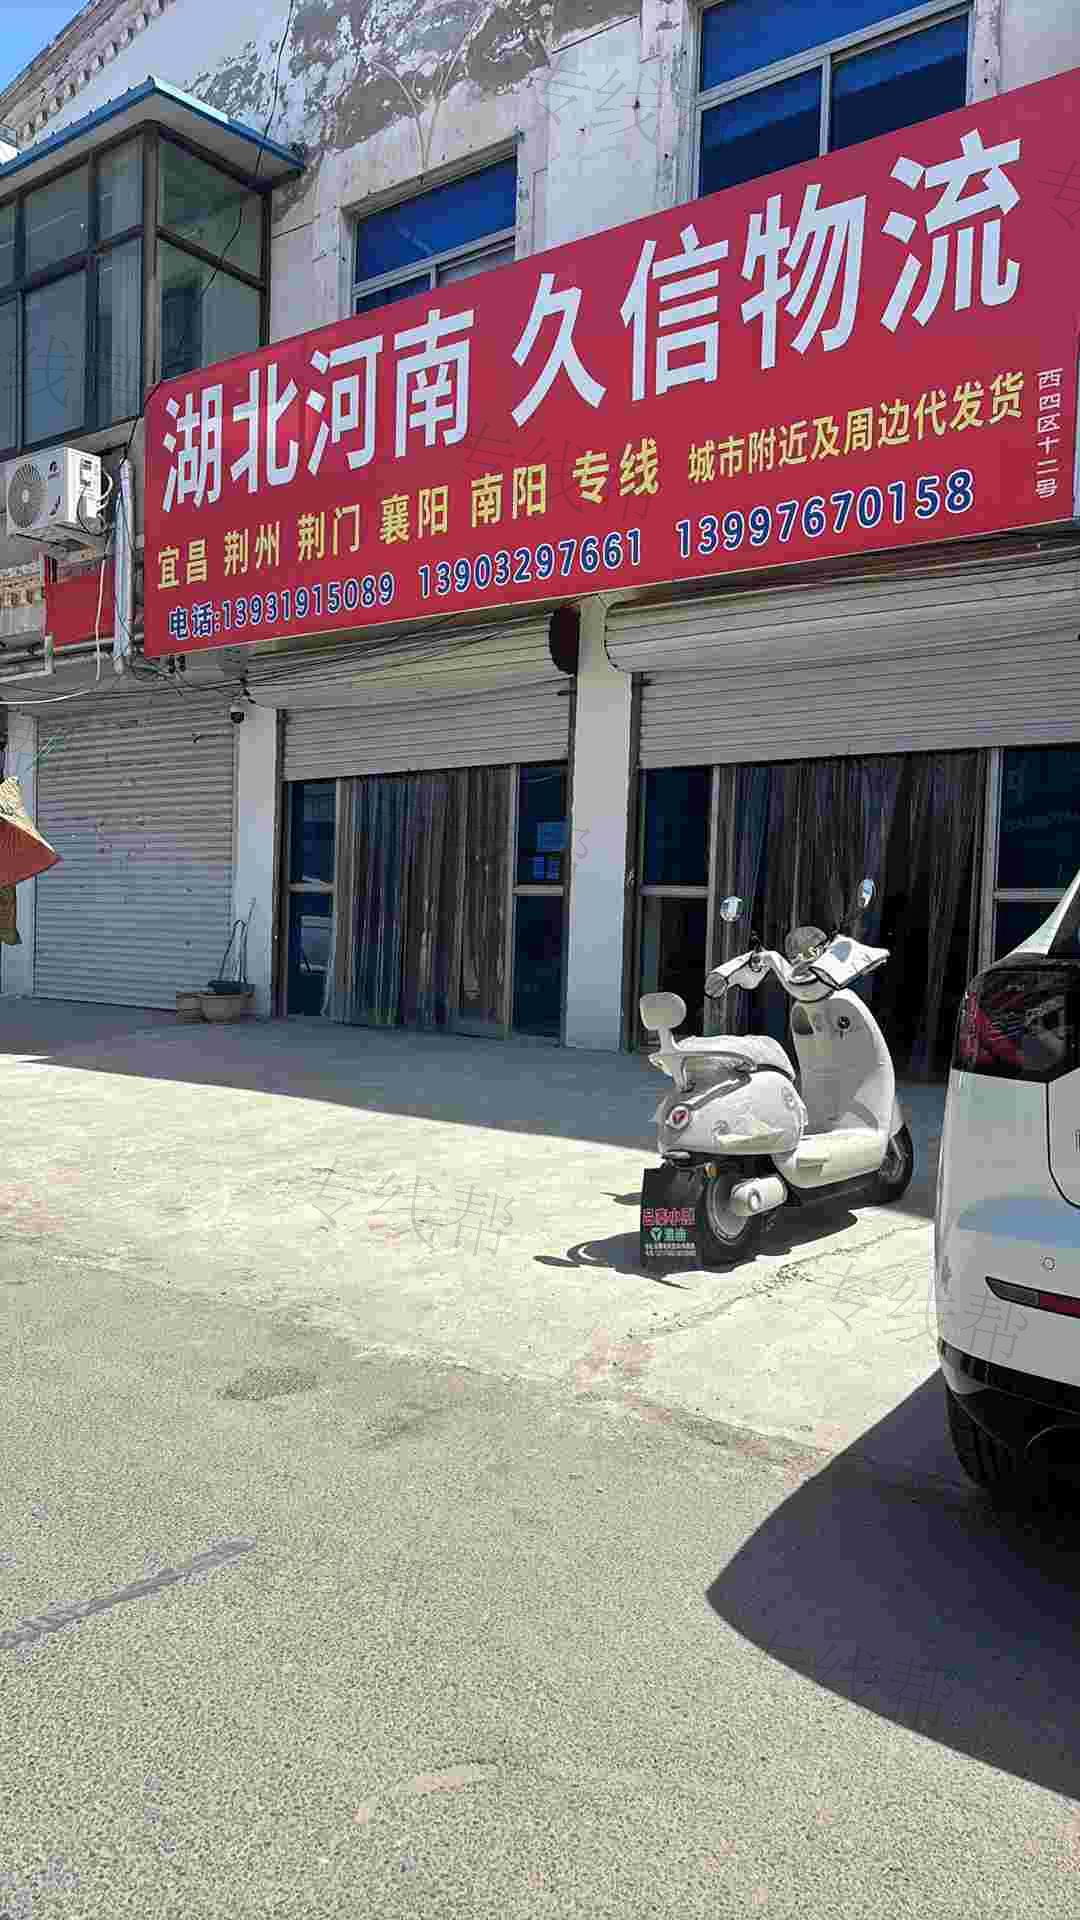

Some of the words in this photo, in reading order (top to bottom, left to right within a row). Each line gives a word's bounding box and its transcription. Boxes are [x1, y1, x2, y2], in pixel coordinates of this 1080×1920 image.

[160, 307, 476, 514] 湖北河南
[510, 127, 1022, 427] 久信物流
[156, 537, 209, 591] 宜昌
[223, 519, 282, 577] 荆州
[296, 502, 361, 562] 荆门
[379, 483, 449, 546] 襄阳
[469, 462, 548, 527] 南阳
[571, 436, 660, 505] 专线
[687, 370, 1026, 485] 城市附近及周边代发货
[1035, 368, 1063, 499] 西四区十二号
[417, 527, 642, 600] 13903297661
[677, 468, 976, 559] 13997670158
